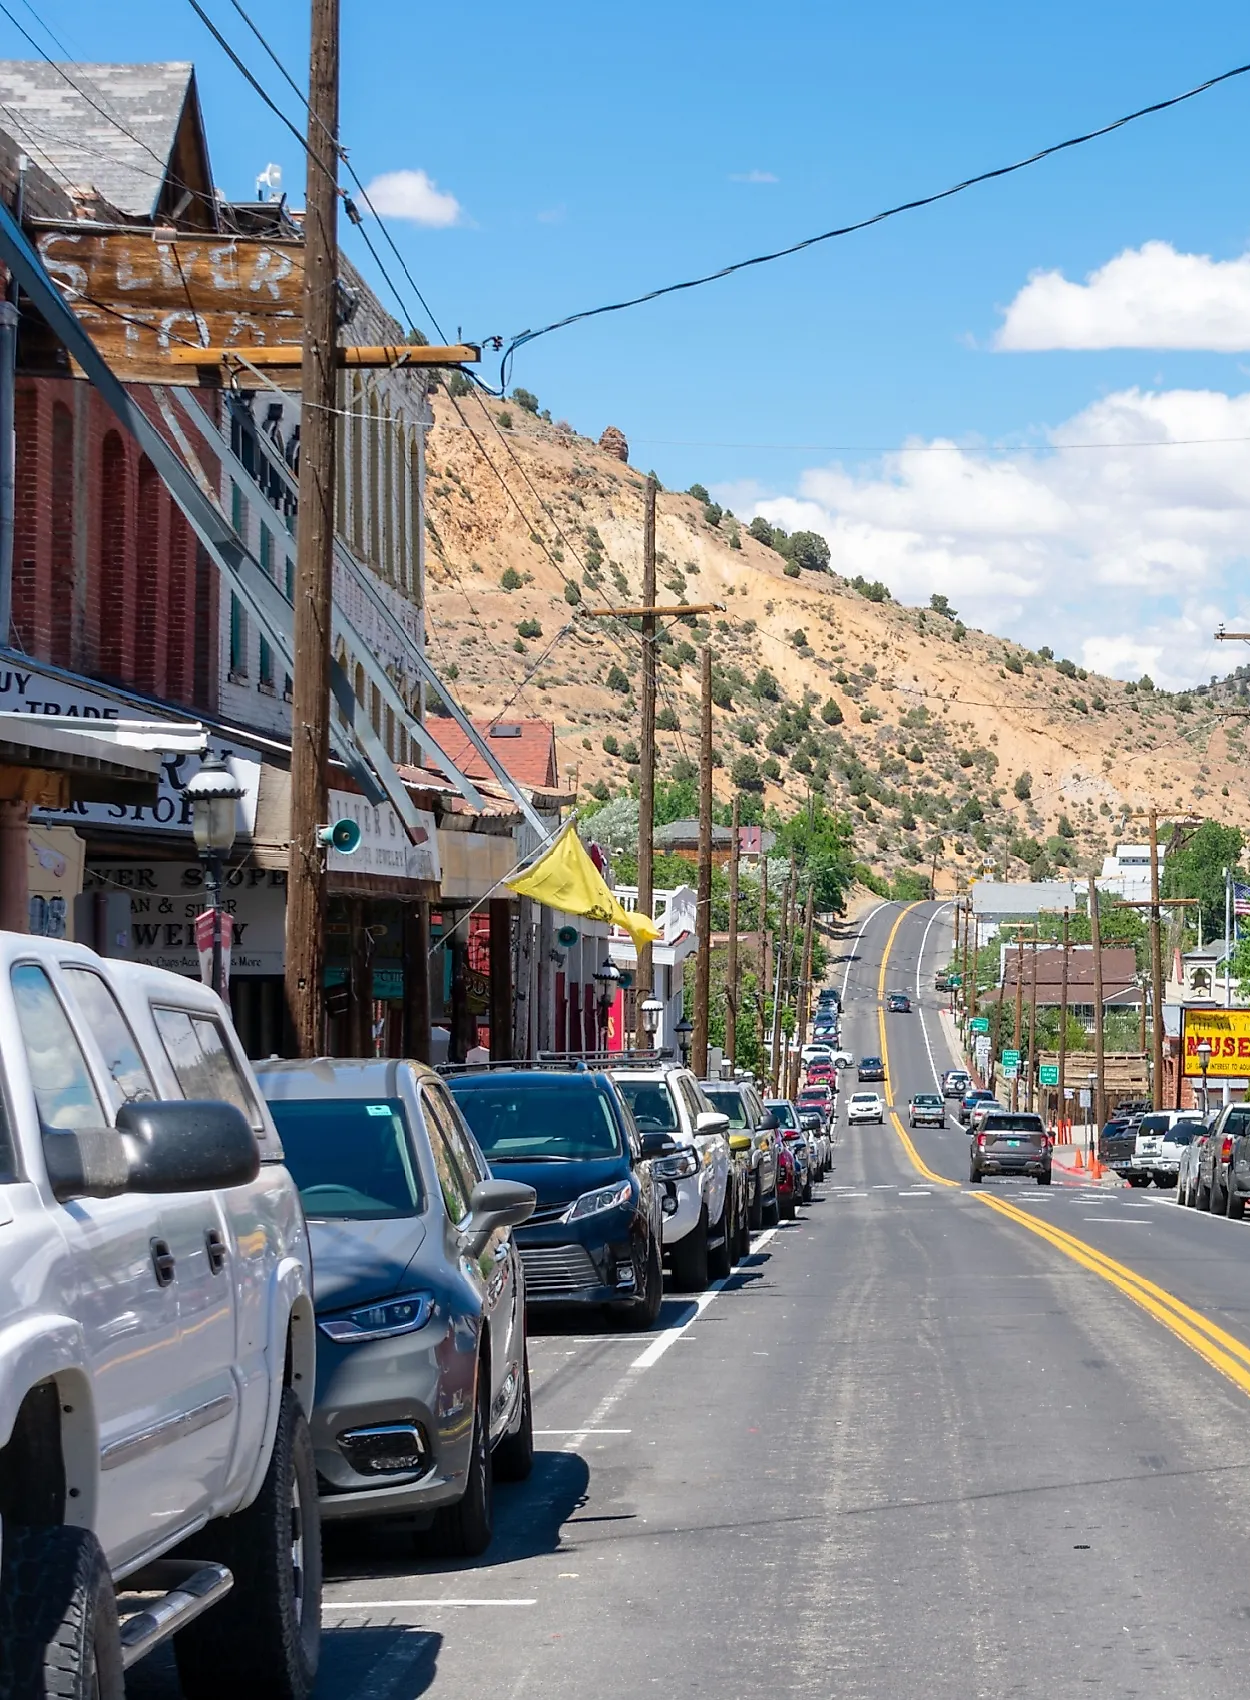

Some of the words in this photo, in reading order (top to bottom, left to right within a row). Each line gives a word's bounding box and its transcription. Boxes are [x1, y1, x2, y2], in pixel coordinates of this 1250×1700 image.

[36, 232, 295, 300] SILVER
[0, 671, 33, 695] UY
[84, 867, 157, 889] LVER
[183, 867, 286, 888] SOPE
[158, 897, 174, 914] &
[1216, 1023, 1237, 1032] WAY
[1210, 1063, 1230, 1071] INTEREST
[1231, 1063, 1238, 1071] TO
